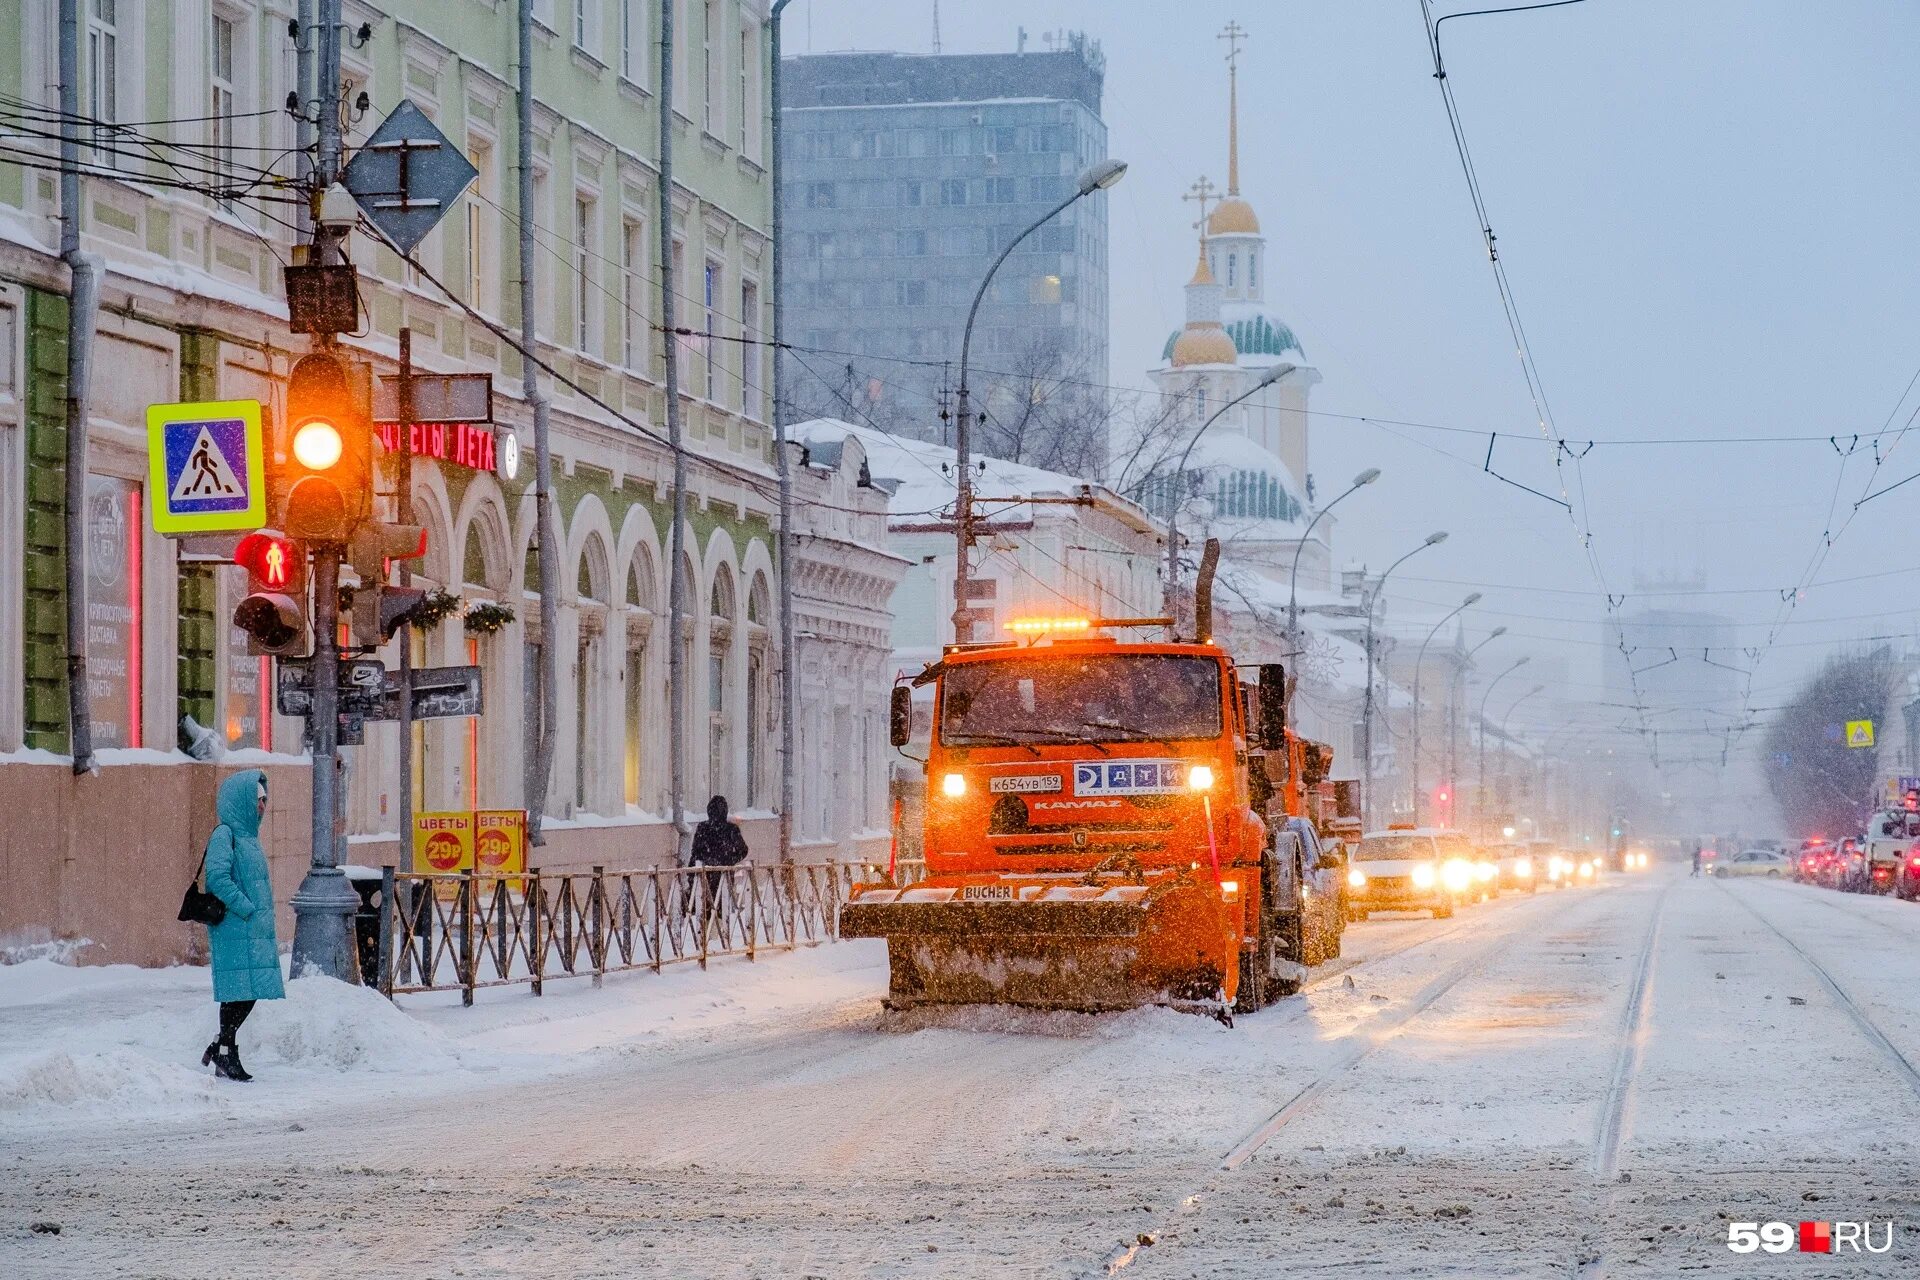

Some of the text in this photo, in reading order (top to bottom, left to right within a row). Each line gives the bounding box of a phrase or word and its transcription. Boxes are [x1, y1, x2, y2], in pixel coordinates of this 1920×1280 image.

[456, 424, 496, 471] ЛЕТА
[994, 777, 1059, 791] К654УВ 159
[1034, 800, 1122, 809] KAMAZ
[419, 818, 468, 830] ЦВЕТЫ
[480, 816, 517, 827] ВЕТЫ
[965, 885, 1011, 899] BUCHER
